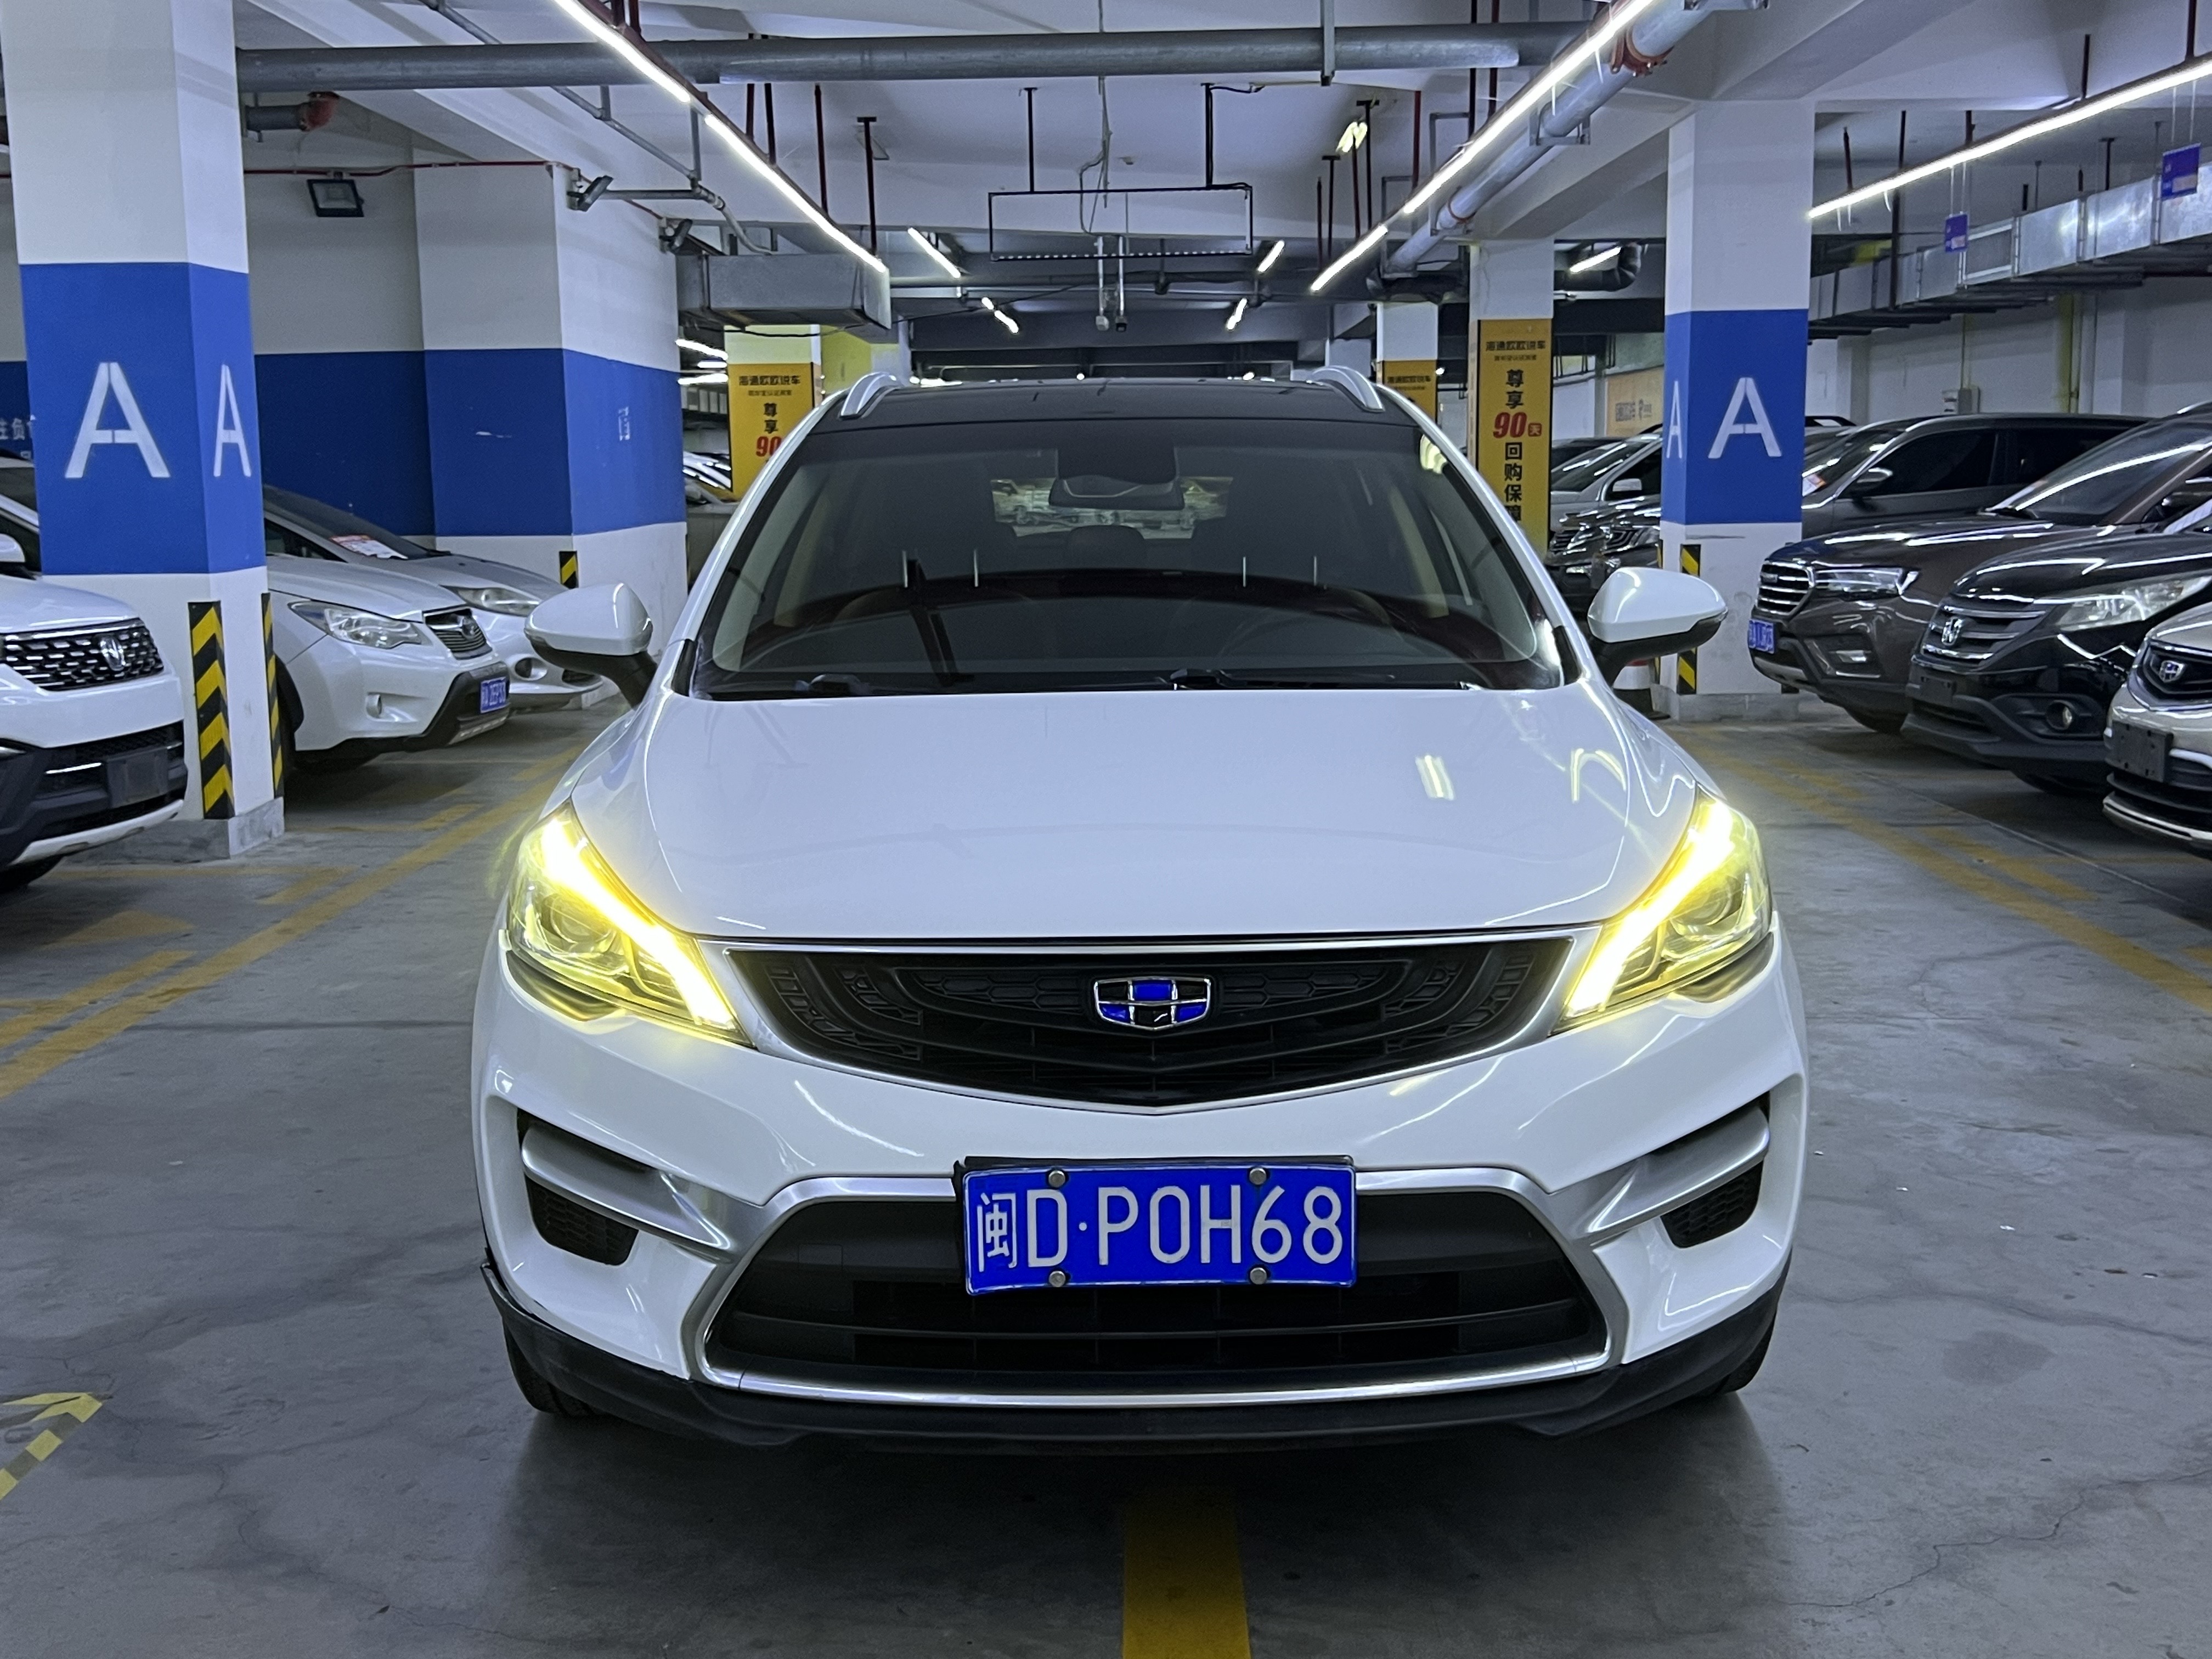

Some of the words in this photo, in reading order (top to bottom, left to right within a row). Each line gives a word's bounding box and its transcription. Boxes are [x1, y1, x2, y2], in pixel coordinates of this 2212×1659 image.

[65, 362, 171, 478] A
[213, 363, 252, 477] A
[1666, 380, 1683, 459] A
[1707, 377, 1782, 459] A
